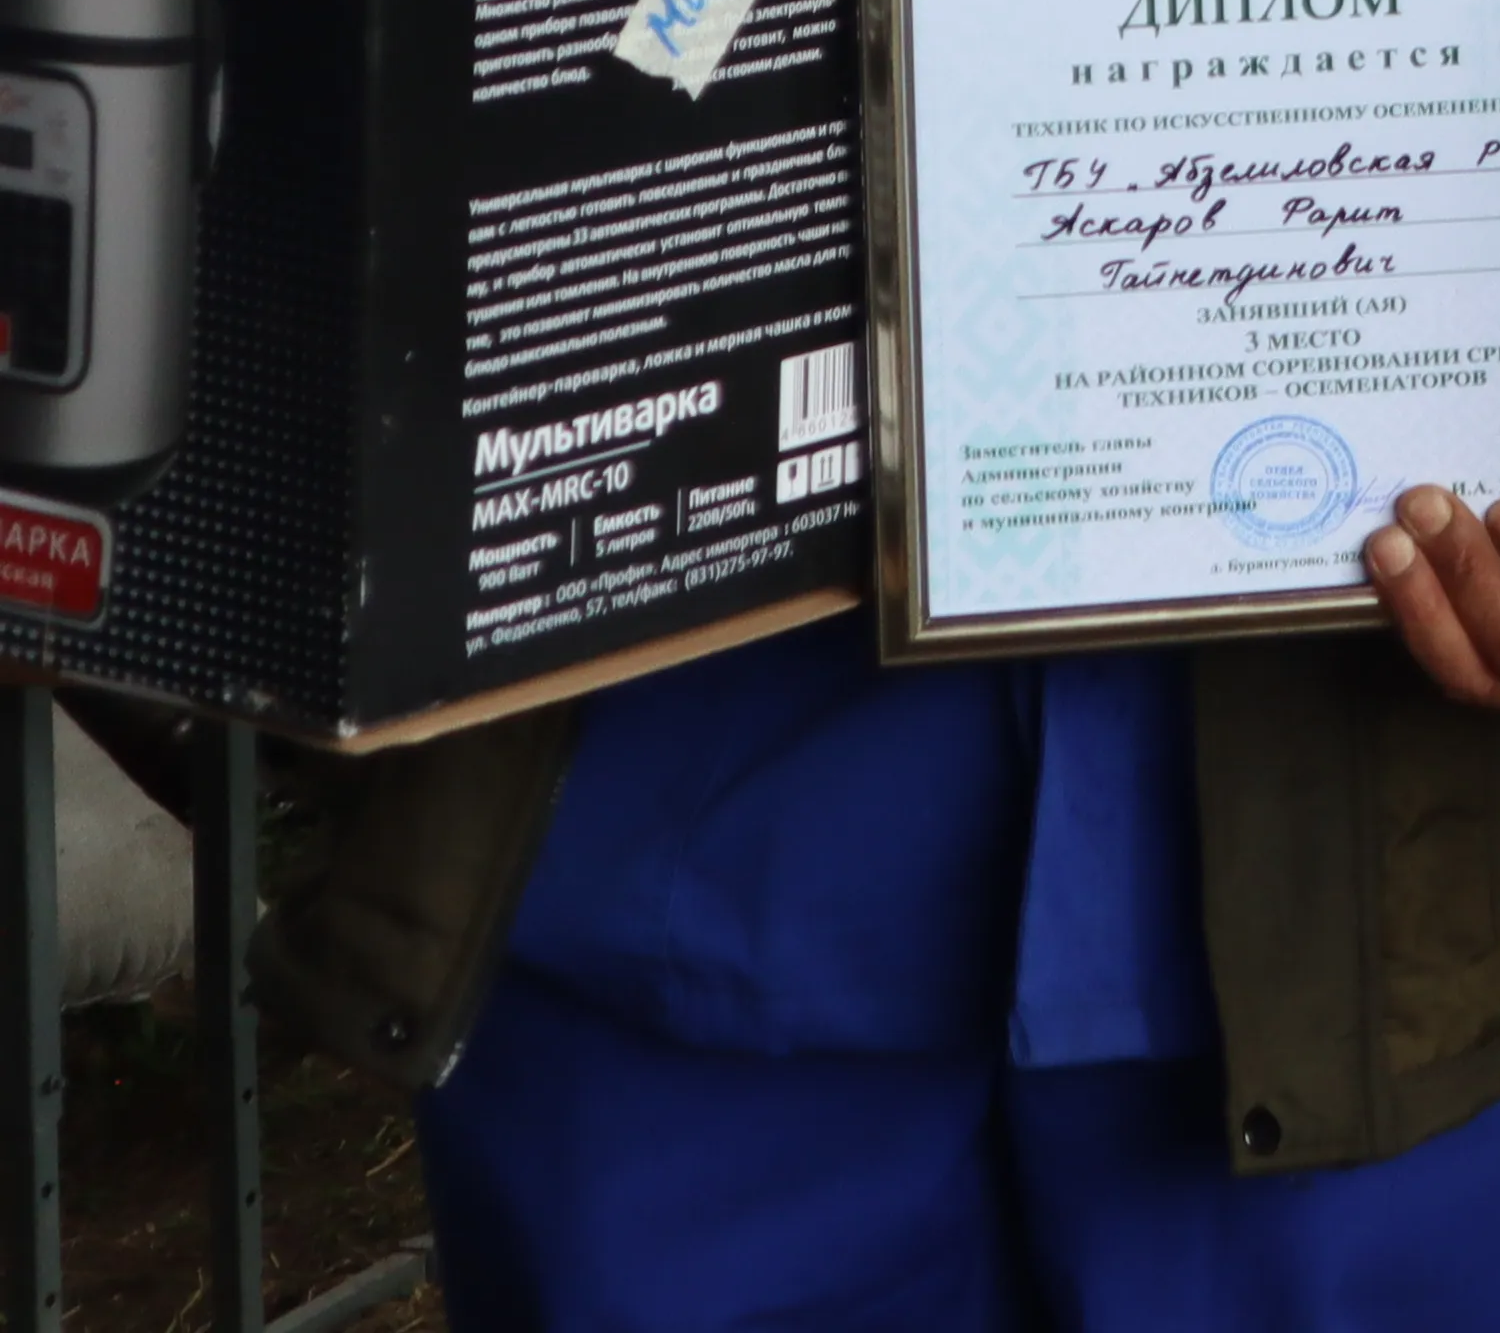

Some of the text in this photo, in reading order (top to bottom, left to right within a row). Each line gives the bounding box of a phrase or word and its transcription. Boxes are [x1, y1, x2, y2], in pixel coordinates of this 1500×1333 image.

[1072, 45, 1460, 86] награждается
[1016, 118, 1108, 138] ТЕХНИК
[1114, 117, 1147, 133] ПО
[1153, 105, 1367, 131] ИСКУССТВЕННОМУ
[1197, 295, 1407, 324] ЗАНЯВШИЙ (АЯ)
[1245, 328, 1362, 353] 3 МЕСТО
[1055, 372, 1090, 390] НА
[1097, 362, 1245, 387] РАЙОННОМ
[1252, 348, 1460, 377] СОРЕВНОВАНИИ
[1117, 369, 1487, 408] ТЕХНИКОВ ОСЕМЕНАТОРОВ
[474, 380, 722, 476] Мультиварка
[472, 462, 631, 532] MAX-MRC-10
[689, 476, 756, 510] Питание
[3, 520, 91, 569] АРКА
[468, 532, 559, 571] Мощность
[606, 527, 656, 555] литров
[660, 547, 703, 573] Адрес
[791, 503, 842, 534] 603037
[478, 568, 507, 591] 900
